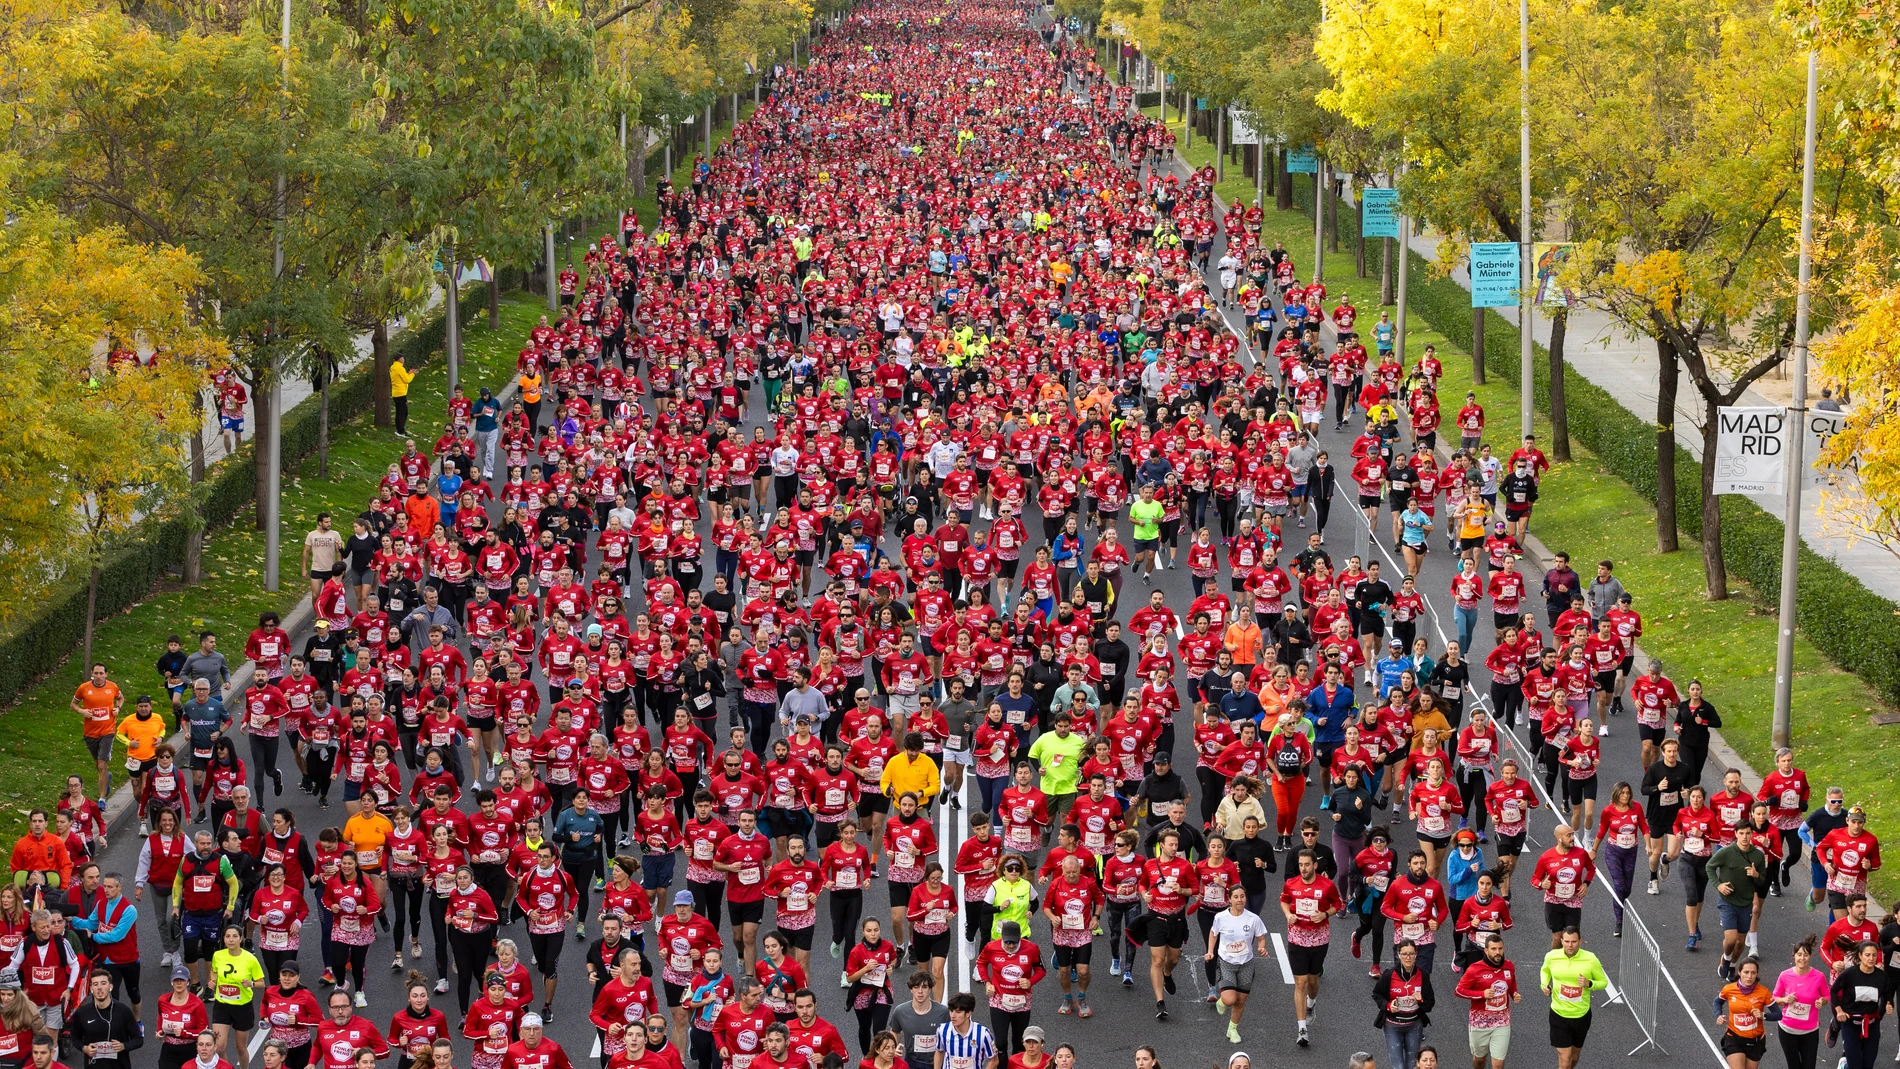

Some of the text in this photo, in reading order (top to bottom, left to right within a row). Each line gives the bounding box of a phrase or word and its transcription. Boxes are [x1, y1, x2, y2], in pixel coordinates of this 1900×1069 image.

[1476, 260, 1515, 269] Gabriele
[1479, 269, 1512, 277] Münter
[1721, 414, 1783, 434] MAD
[1741, 435, 1781, 456] RID
[1717, 455, 1748, 478] ES
[1738, 484, 1765, 492] MADRID
